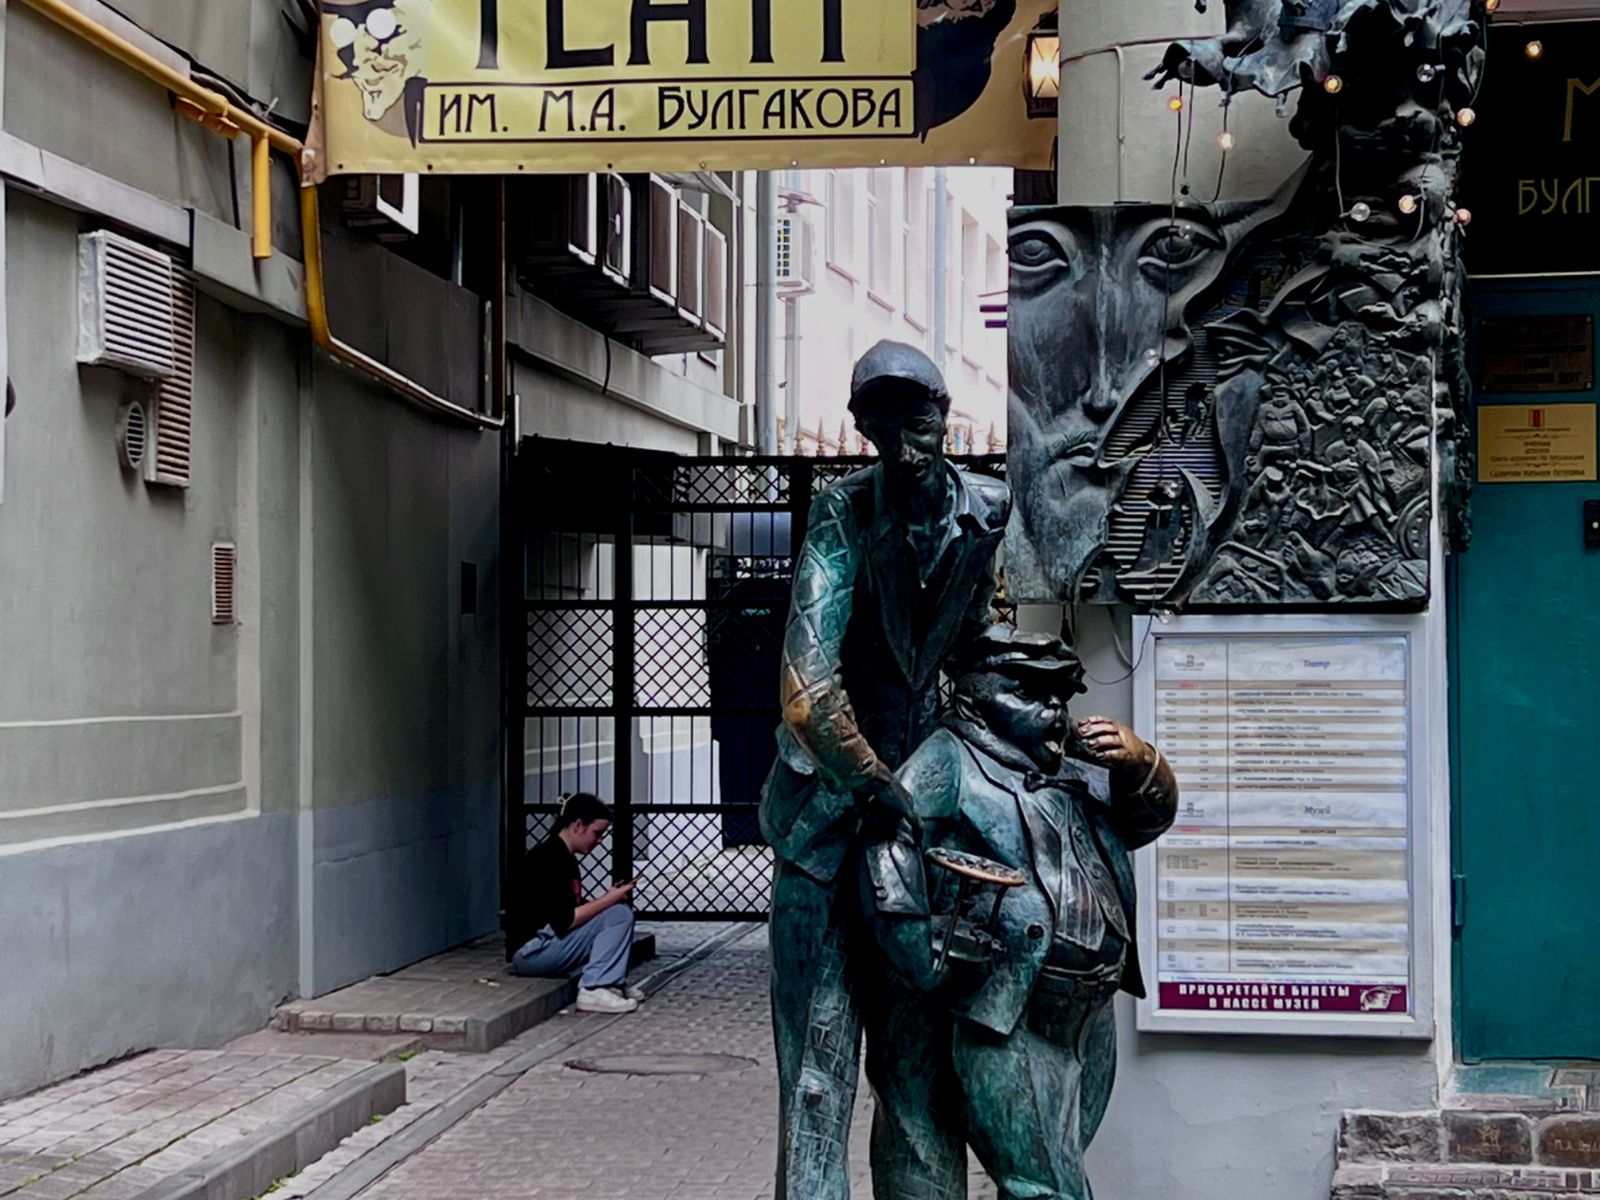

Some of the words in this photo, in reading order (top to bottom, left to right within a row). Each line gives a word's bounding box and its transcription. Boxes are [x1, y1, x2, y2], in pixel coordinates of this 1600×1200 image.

[440, 94, 508, 136] ИМ.
[539, 90, 626, 132] М.А.
[659, 87, 902, 131] БУЛГАКОВА
[1179, 983, 1286, 996] ПРИОБРЕТАЙТЕ
[1291, 985, 1351, 997] БИЛЕТЫ
[1209, 998, 1217, 1008] В
[1223, 998, 1268, 1009] КАССЕ
[1273, 998, 1320, 1009] МУЗЕЯ
